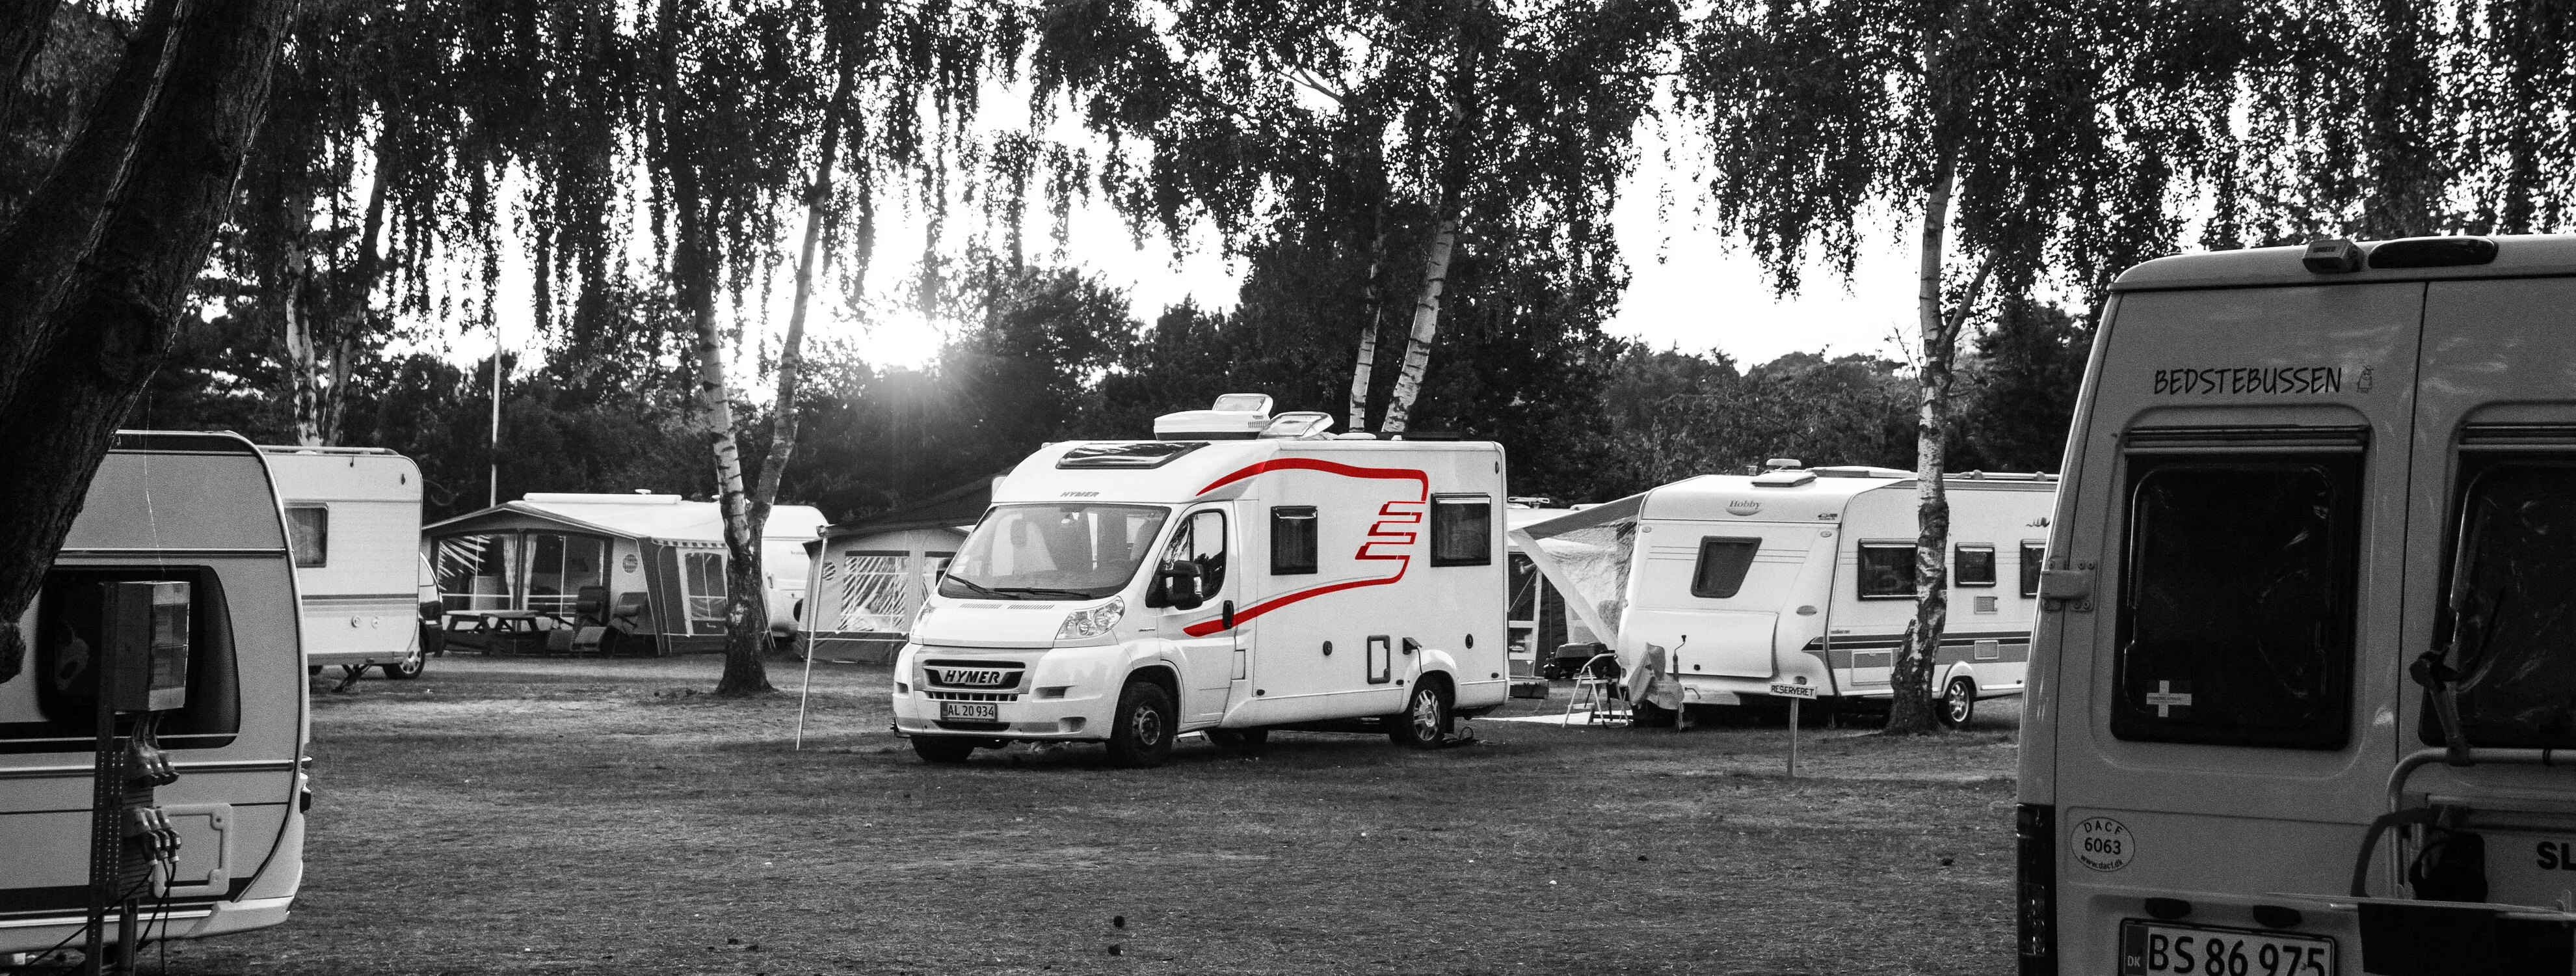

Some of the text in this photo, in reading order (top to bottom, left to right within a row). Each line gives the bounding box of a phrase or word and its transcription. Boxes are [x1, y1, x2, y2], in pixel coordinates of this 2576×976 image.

[2154, 367, 2341, 395] BEDSTEBUSSEN
[1729, 500, 1760, 509] Hobby
[944, 670, 1000, 683] HYMER
[1771, 685, 1814, 696] RESERVERET
[948, 705, 994, 716] AL 20 934
[2083, 820, 2123, 835] DACF
[2084, 837, 2121, 855] 6063
[2080, 854, 2123, 869] www.dacf.dk
[2127, 955, 2141, 968] DK
[2149, 933, 2325, 976] BS 86 975
